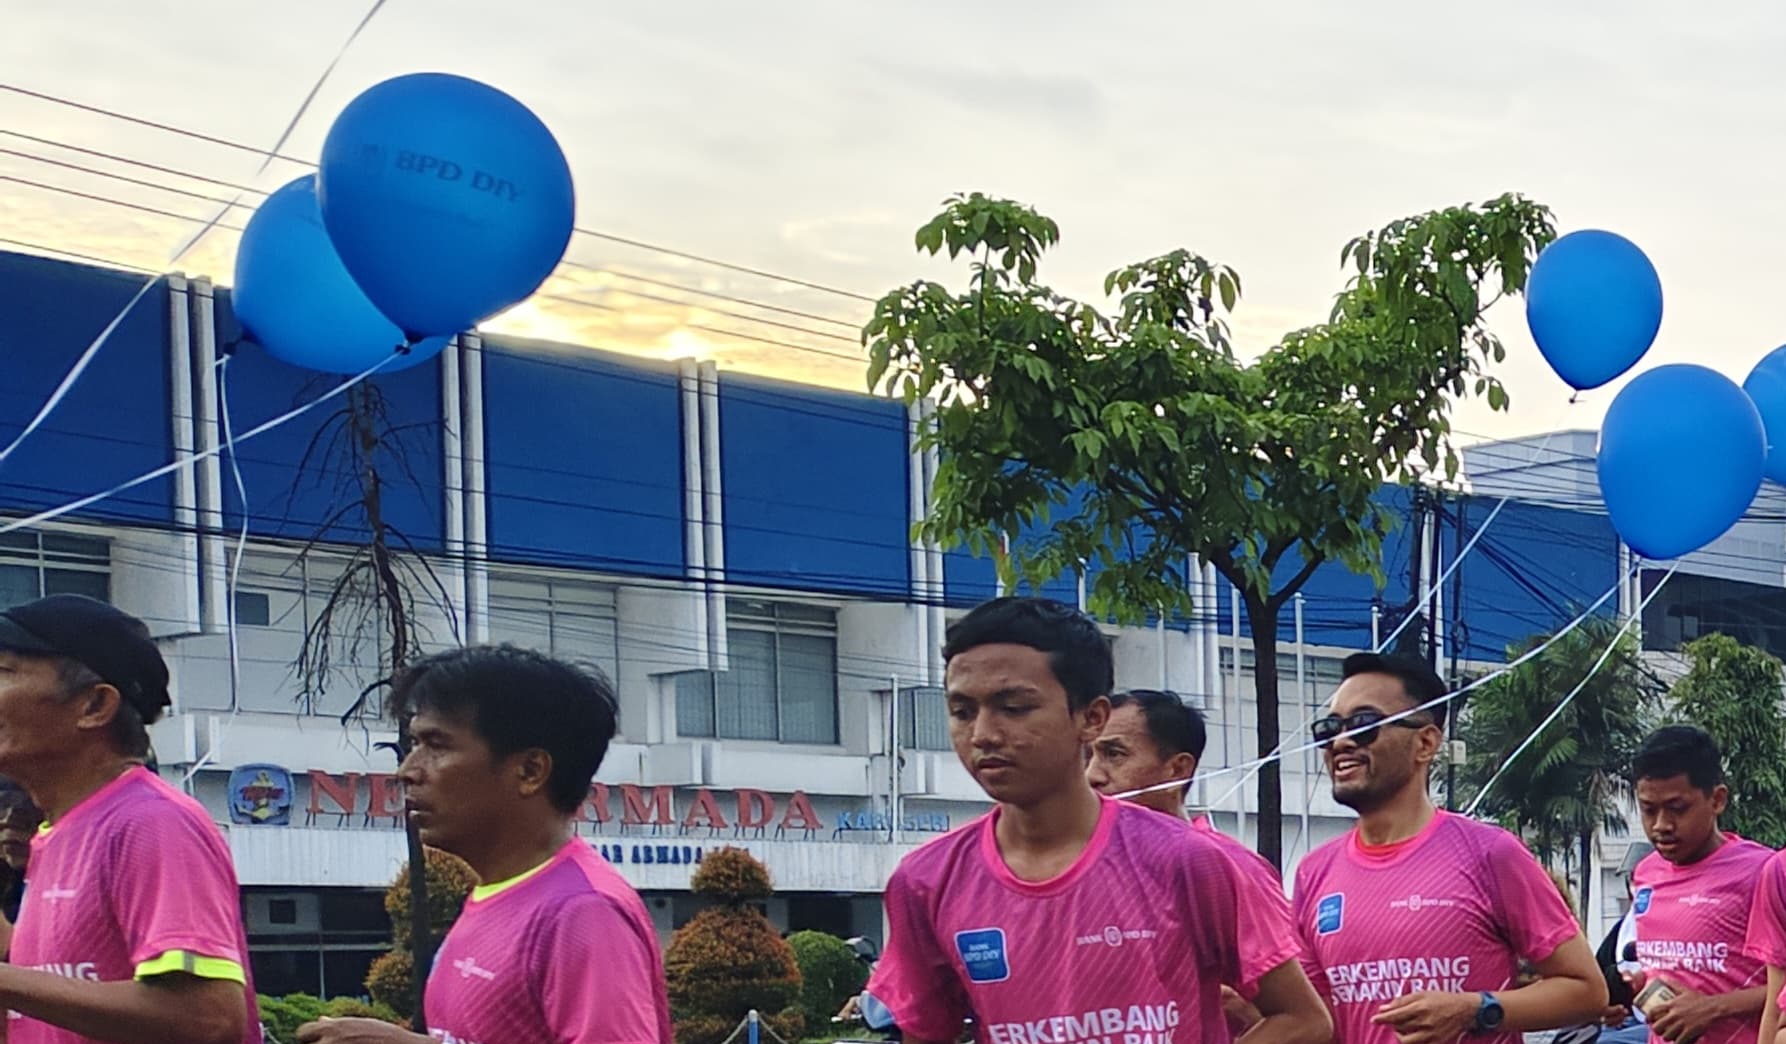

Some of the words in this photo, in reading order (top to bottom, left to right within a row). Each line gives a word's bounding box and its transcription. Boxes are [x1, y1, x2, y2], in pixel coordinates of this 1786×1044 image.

[307, 769, 404, 817] NE
[576, 781, 823, 829] RMADA
[837, 811, 950, 831] KARSERI
[1325, 955, 1470, 986] ERKEMBANG
